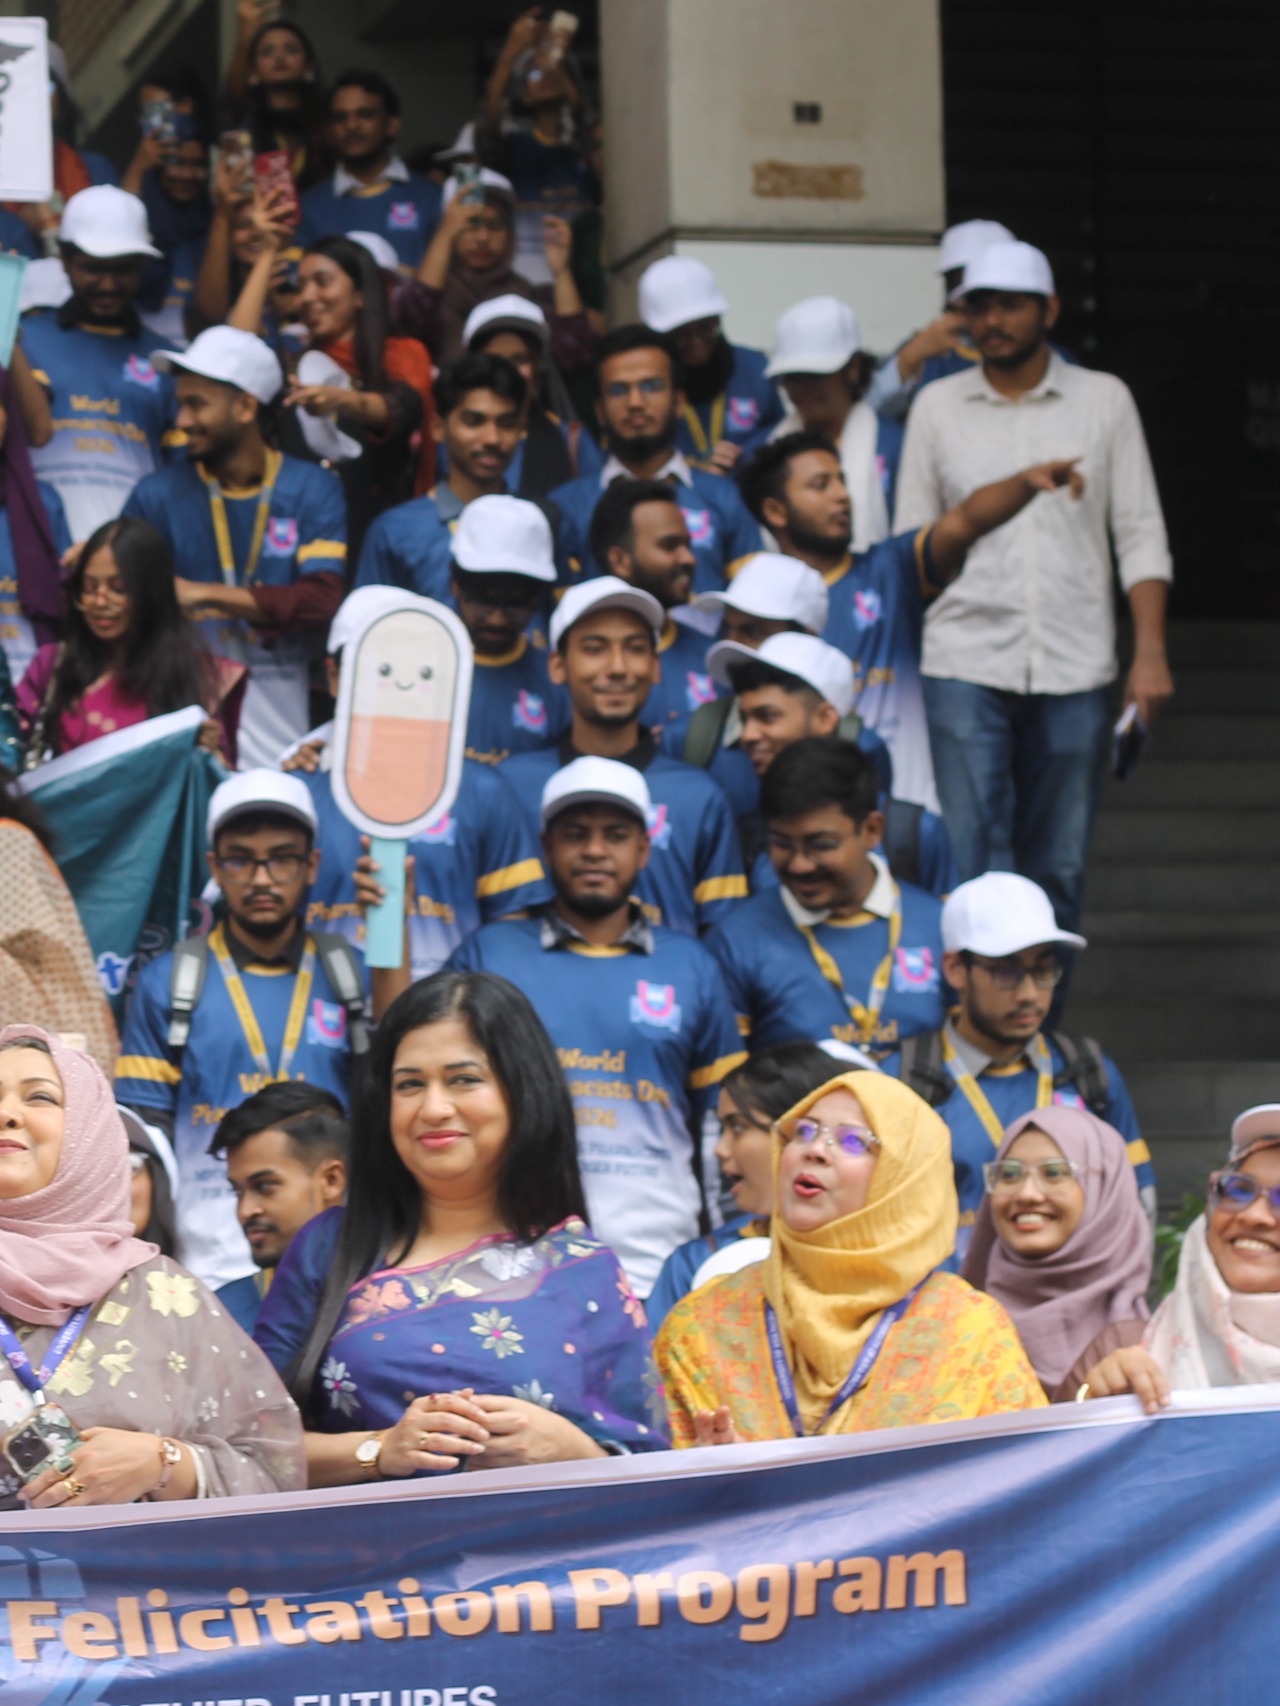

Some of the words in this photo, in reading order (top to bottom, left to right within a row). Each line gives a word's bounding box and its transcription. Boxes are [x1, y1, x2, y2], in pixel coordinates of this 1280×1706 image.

[573, 1106, 617, 1130] 026
[6, 1576, 552, 1662] Felicitation
[567, 1549, 968, 1645] Program
